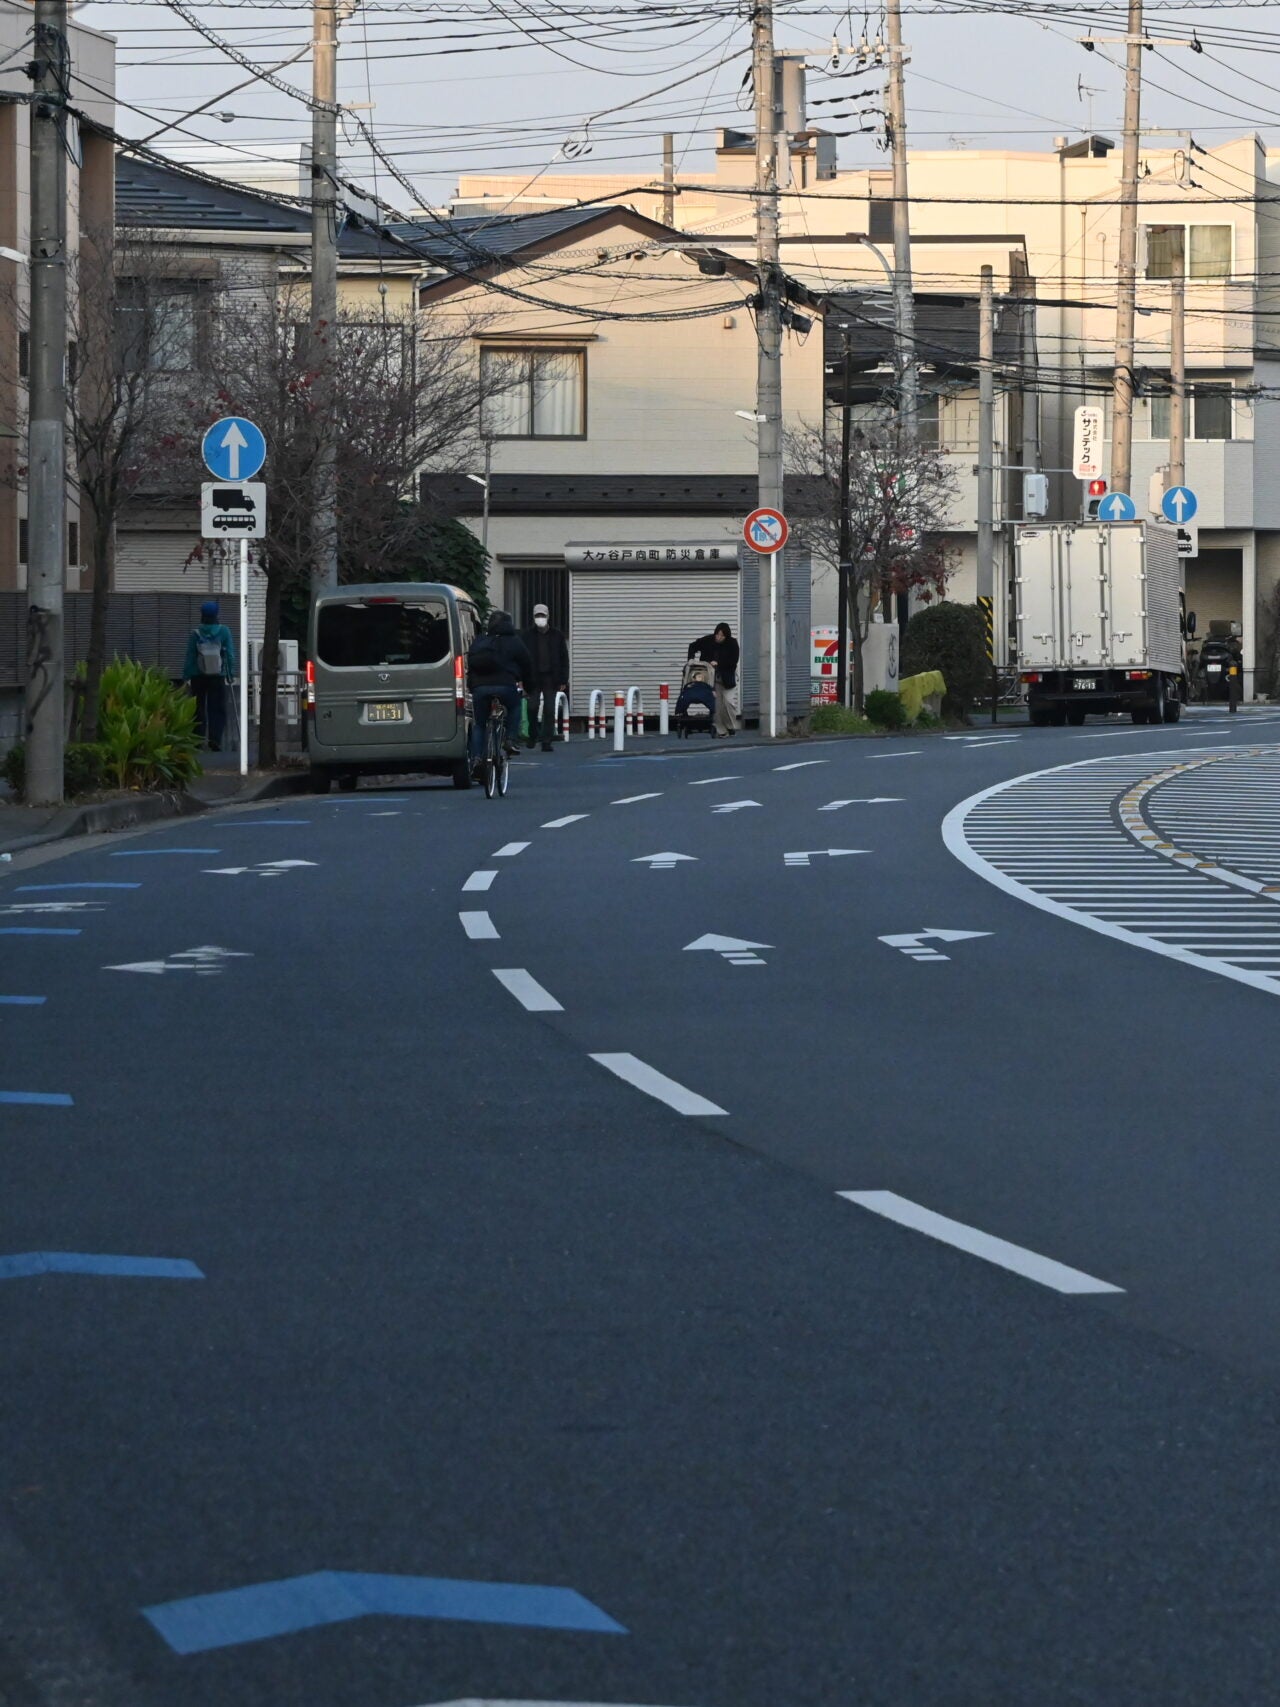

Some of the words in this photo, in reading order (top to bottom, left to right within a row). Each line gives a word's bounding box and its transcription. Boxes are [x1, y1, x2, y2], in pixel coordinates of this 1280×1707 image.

[1082, 418, 1091, 464] サンテック
[665, 549, 720, 561] 防災倉庫
[814, 656, 838, 664] ELEVE
[376, 709, 401, 720] 11-31
